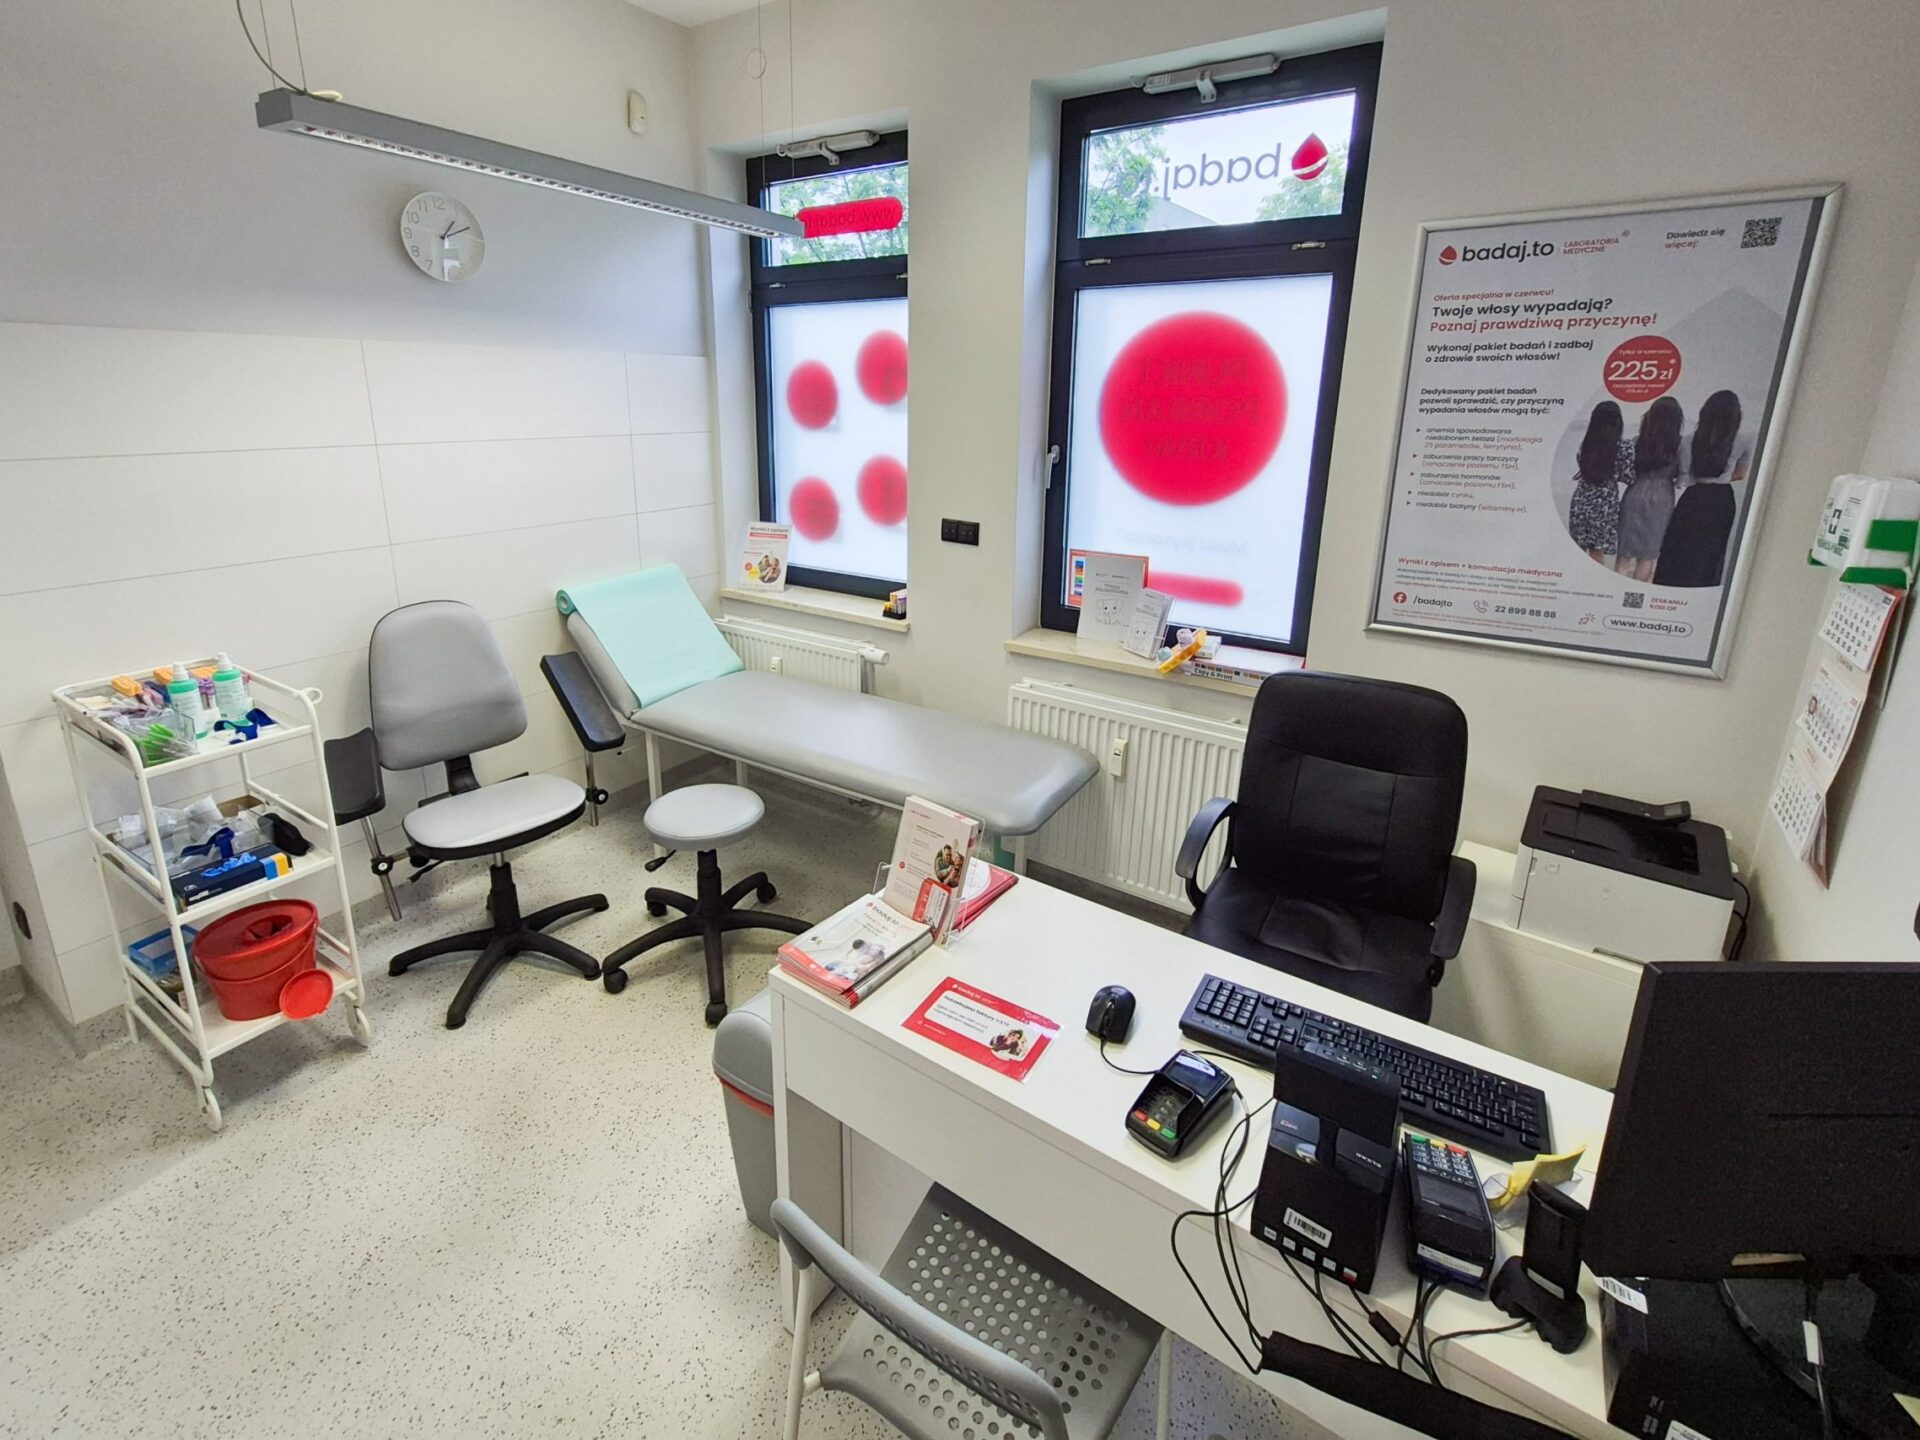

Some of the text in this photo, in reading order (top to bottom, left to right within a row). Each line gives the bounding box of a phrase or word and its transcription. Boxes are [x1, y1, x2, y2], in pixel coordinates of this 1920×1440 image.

[418, 200, 428, 213] 11
[433, 196, 445, 210] 12
[406, 211, 419, 224] 10
[403, 227, 412, 239] 9
[1666, 228, 1725, 239] Dowiedz się
[1564, 237, 1619, 248] LABORATORIA
[411, 245, 419, 257] 8
[1462, 240, 1554, 264] badaj.to
[423, 259, 433, 271] 7
[1461, 291, 1503, 301] specjalna
[1514, 289, 1554, 297] czerwcu!
[1433, 298, 1612, 319] Twoje włosy wypadają?
[1430, 313, 1657, 333] Poznaj prawdziwą przyczynę!
[1427, 342, 1472, 353] Wykonaj
[1474, 342, 1507, 352] pakiet
[1510, 341, 1545, 350] badań
[1554, 340, 1593, 351] zadbaj
[1434, 353, 1473, 363] zdrowie
[1476, 353, 1513, 362] swoich
[1515, 352, 1560, 361] włosów!
[1608, 361, 1658, 380] 225
[1507, 387, 1537, 395] badań
[1419, 397, 1451, 405] pozwoli
[1453, 397, 1499, 405] sprawdzić,
[1517, 398, 1564, 406] przyczyną
[1501, 408, 1529, 416] mogą
[1487, 455, 1519, 463] tarczycy
[1449, 502, 1476, 510] biotyny
[1399, 557, 1423, 566] Wyniki
[1430, 560, 1459, 569] opisem
[1468, 563, 1516, 574] konsultacja
[1518, 568, 1562, 578] medyczna
[1413, 595, 1453, 608] /badajto
[1508, 607, 1527, 615] 899
[1529, 609, 1542, 617] 88
[1544, 610, 1557, 619] 88
[1611, 618, 1686, 634] www.badaj.to
[1195, 668, 1209, 676] Copy
